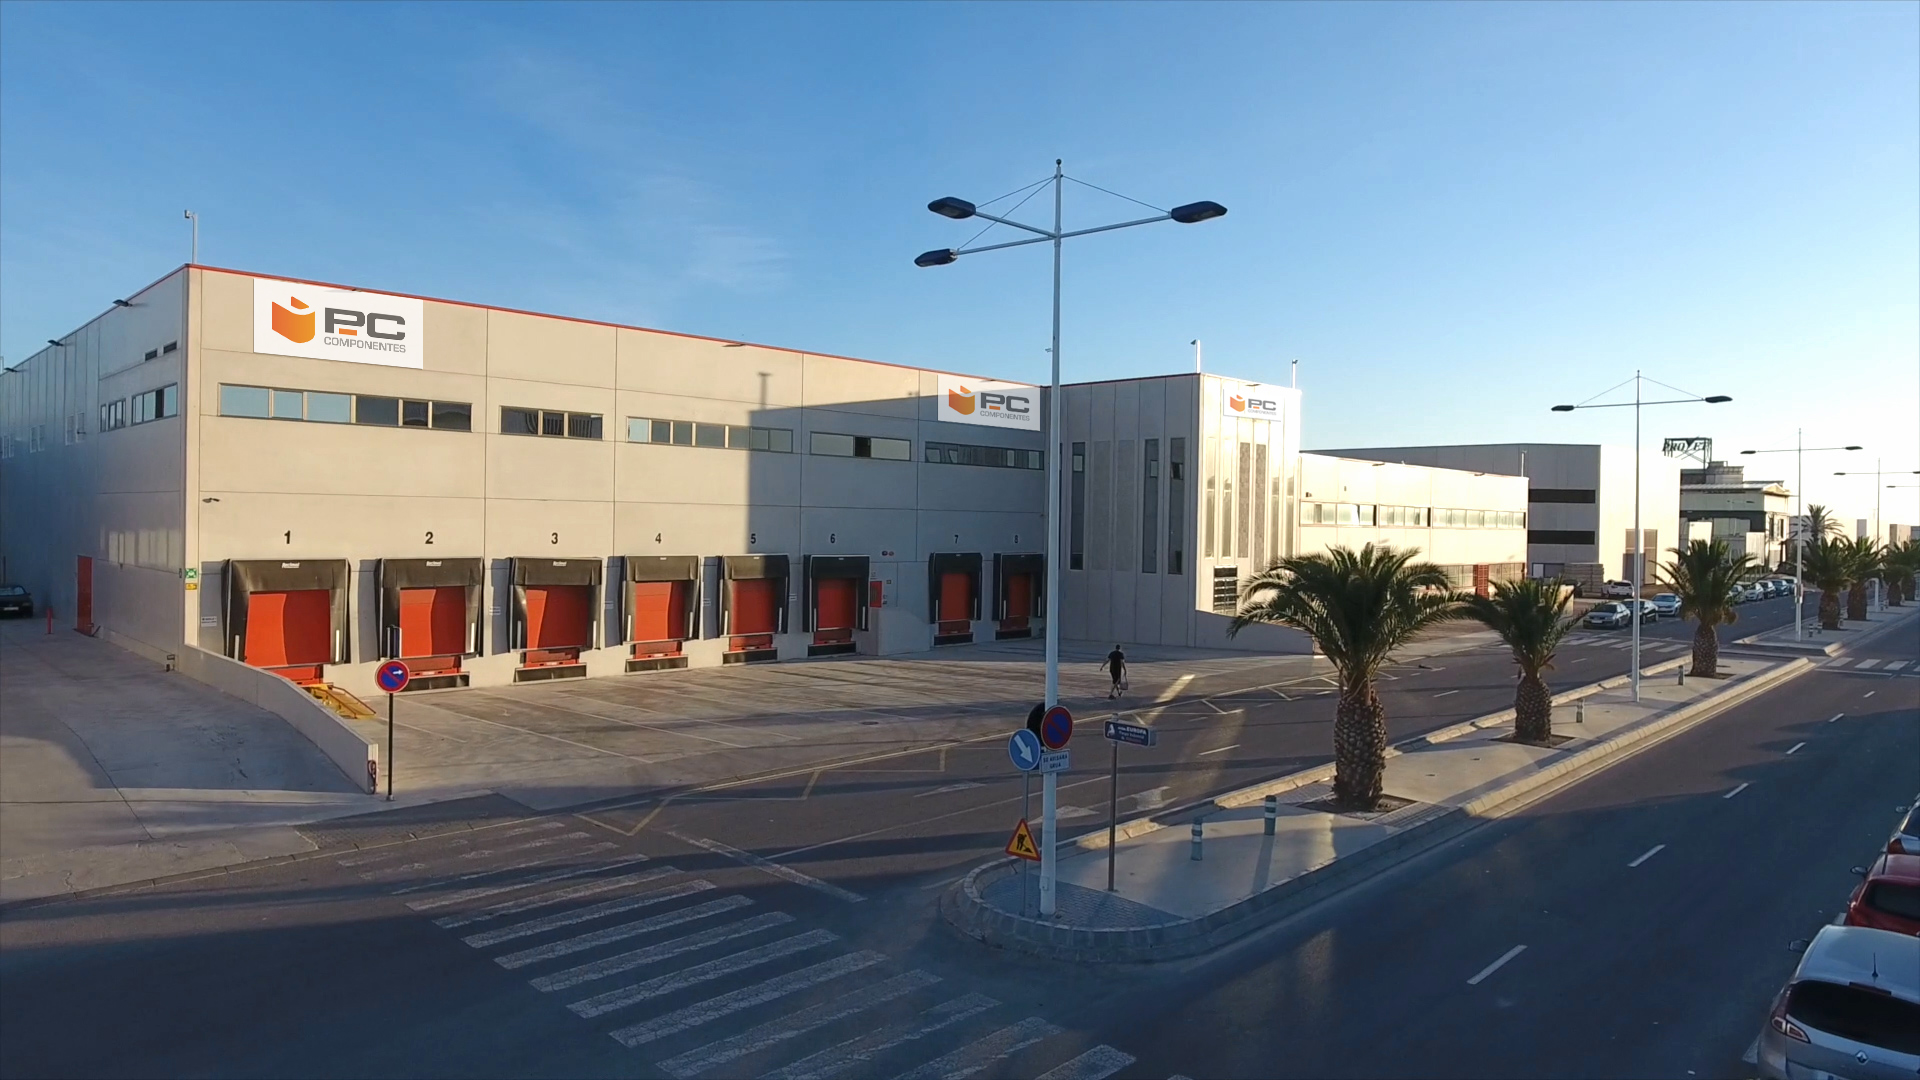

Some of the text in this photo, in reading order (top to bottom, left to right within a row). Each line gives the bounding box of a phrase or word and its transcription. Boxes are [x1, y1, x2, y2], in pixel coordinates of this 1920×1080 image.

[325, 307, 406, 341] PC
[323, 336, 406, 353] COMPONENTES
[980, 392, 1030, 413] PC
[1248, 398, 1277, 411] PC
[979, 410, 1030, 422] COMPONENTES
[284, 531, 291, 545] 1
[425, 531, 434, 544] 2
[551, 532, 558, 545] 3
[655, 532, 661, 544] 4
[750, 533, 757, 545] 5
[830, 533, 836, 544] 6
[954, 534, 959, 544] 7
[1014, 534, 1019, 544] 8
